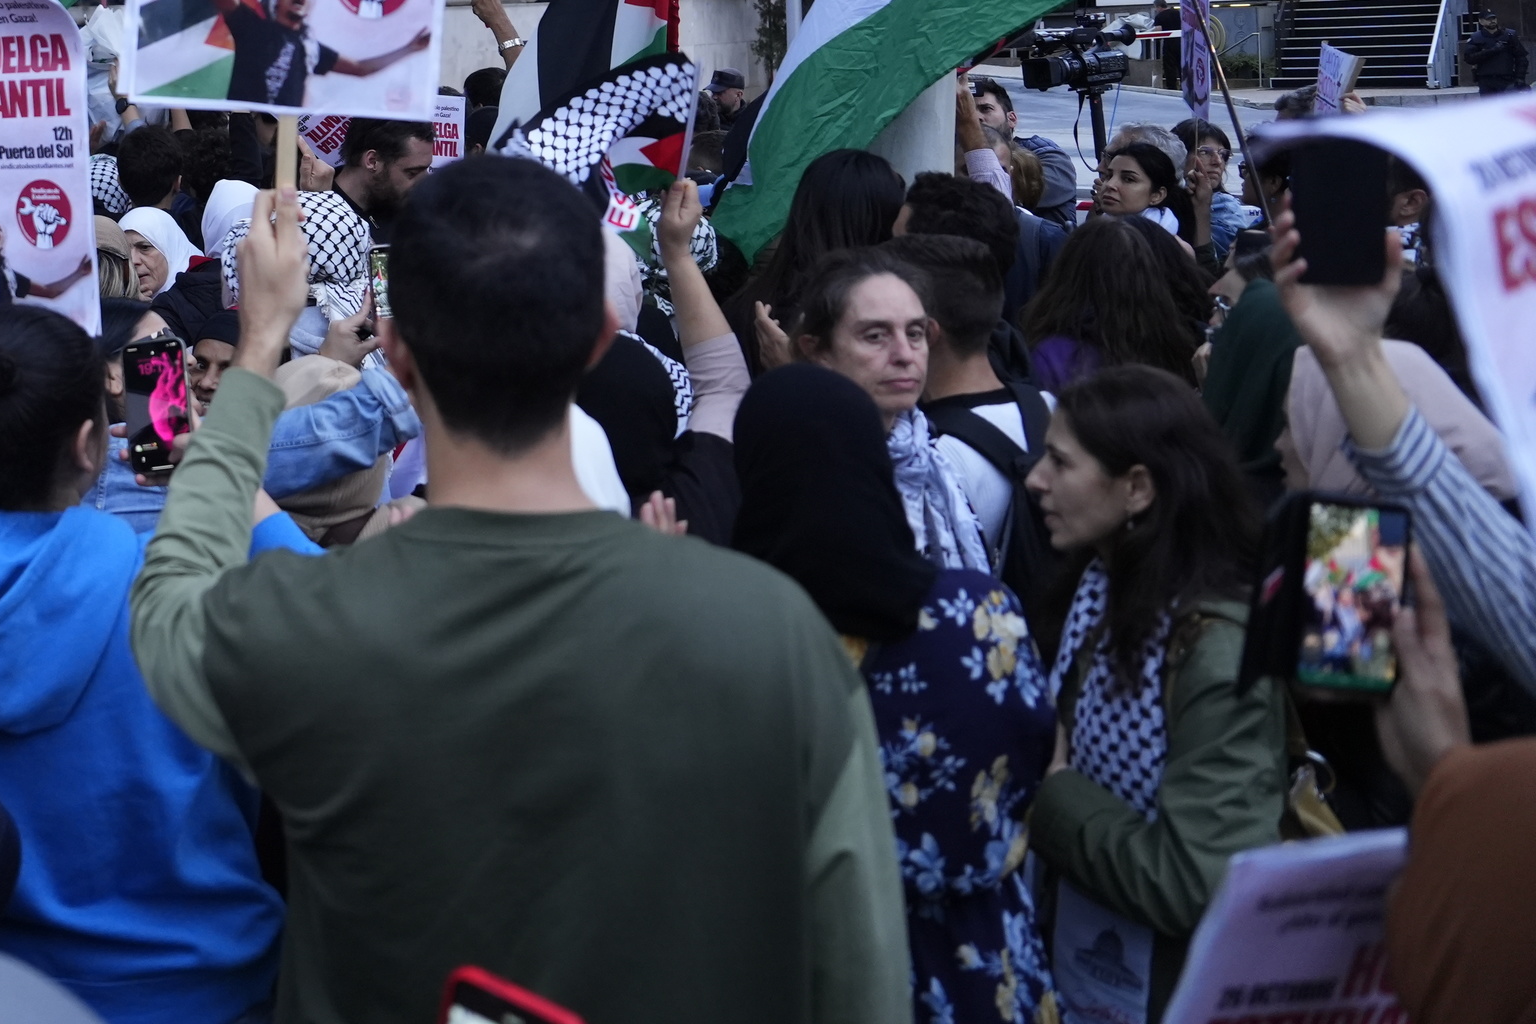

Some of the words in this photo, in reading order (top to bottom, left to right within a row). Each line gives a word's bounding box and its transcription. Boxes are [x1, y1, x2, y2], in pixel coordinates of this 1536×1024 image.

[5, 0, 49, 12] palestino
[10, 13, 38, 24] Gaza!
[52, 126, 73, 141] 12h
[36, 144, 54, 159] del
[56, 143, 74, 158] Sol
